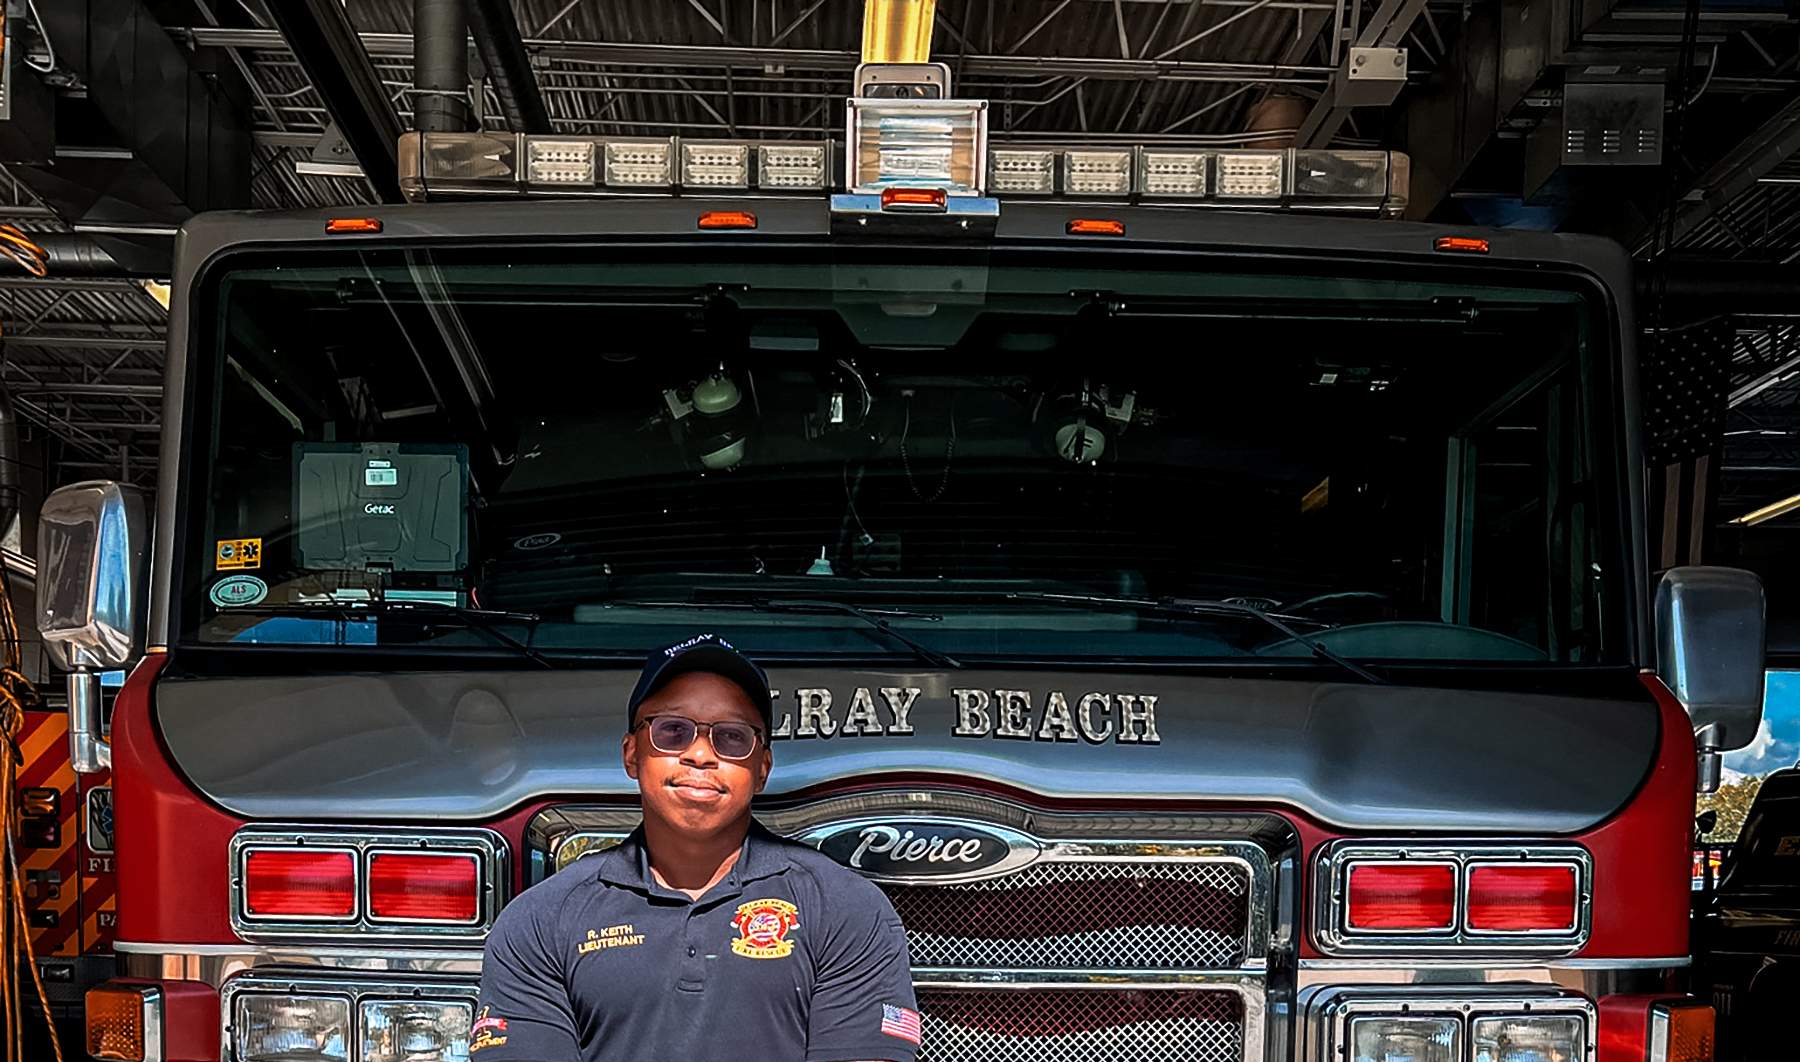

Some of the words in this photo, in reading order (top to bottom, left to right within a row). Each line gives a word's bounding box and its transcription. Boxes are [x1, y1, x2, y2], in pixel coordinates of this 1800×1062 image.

[953, 688, 1160, 744] BEACH
[850, 825, 983, 868] Pierce
[88, 857, 115, 873] FI
[587, 929, 599, 940] R.
[601, 924, 634, 937] KEITH
[578, 935, 645, 953] LIEUTENANT
